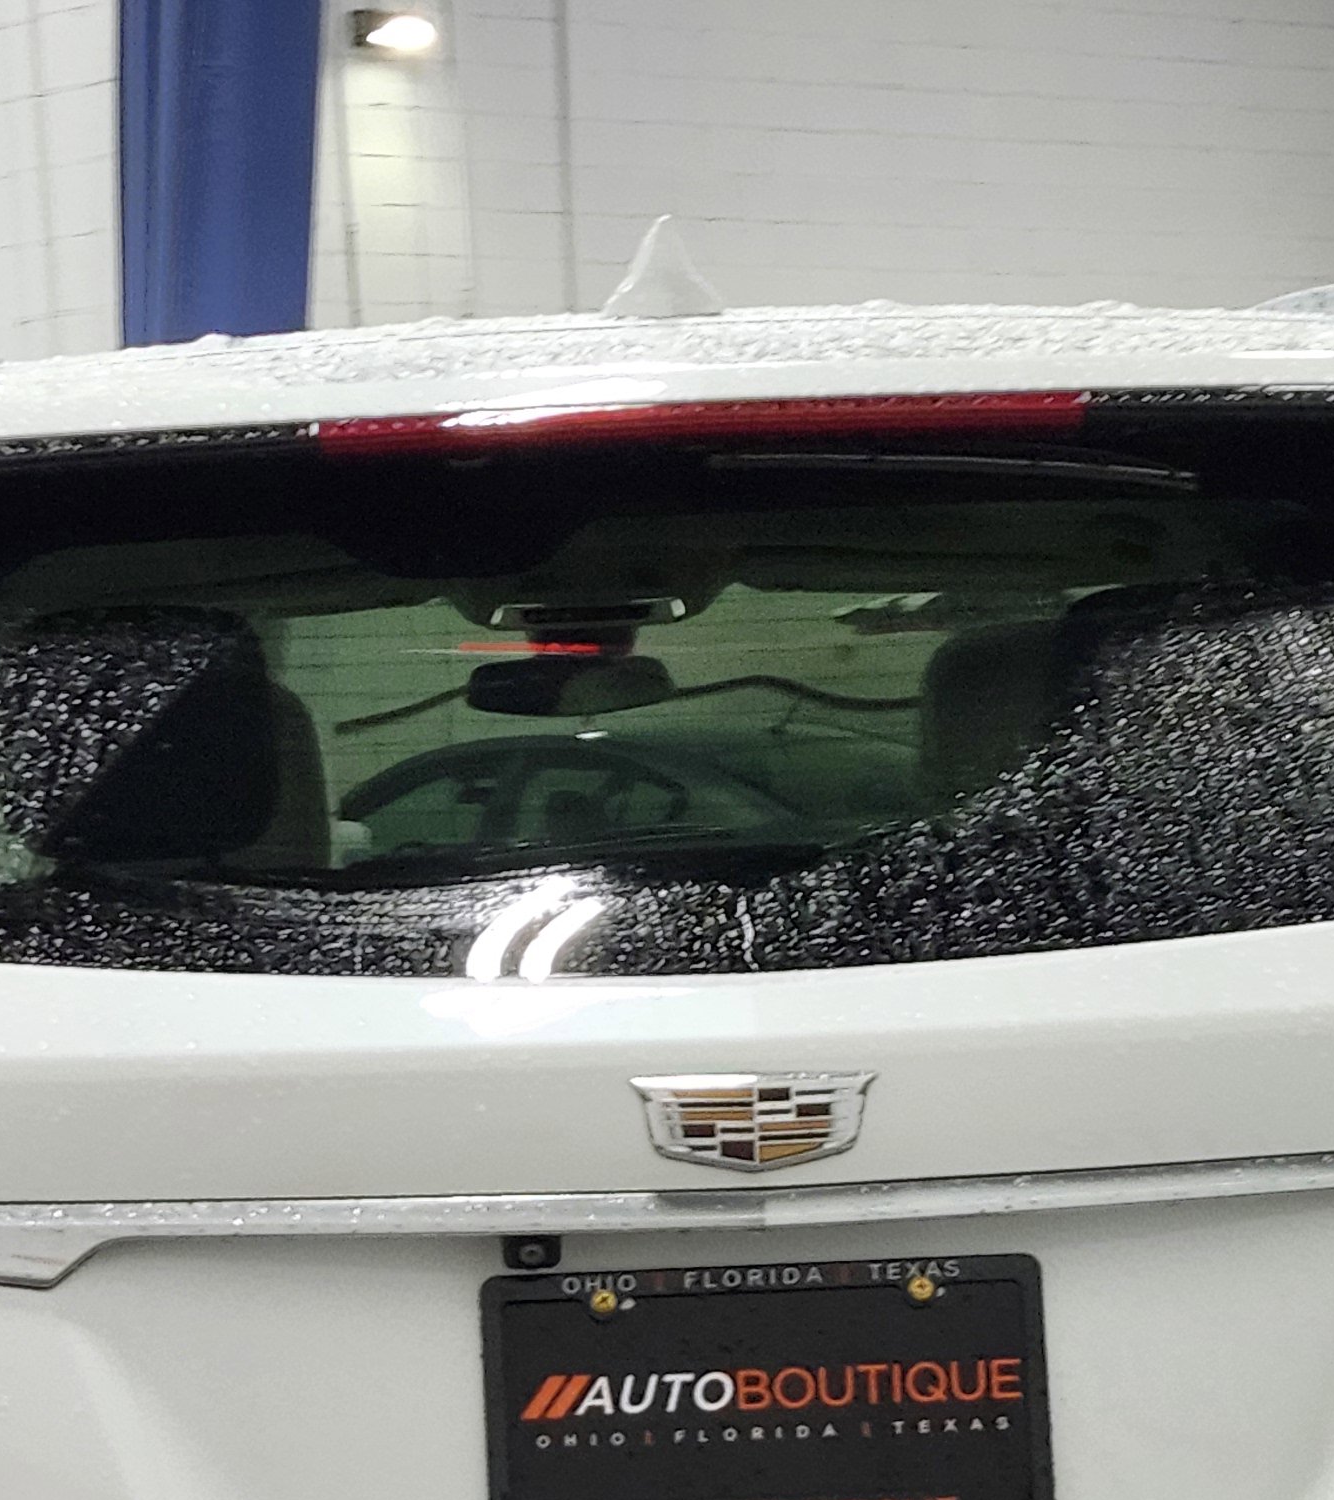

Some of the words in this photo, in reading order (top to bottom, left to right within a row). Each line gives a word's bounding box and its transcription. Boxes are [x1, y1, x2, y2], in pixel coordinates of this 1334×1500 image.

[561, 1273, 638, 1295] OHIO
[682, 1264, 824, 1291] FLORIDA
[868, 1258, 962, 1281] TEXAS
[535, 1432, 626, 1449] OHIO
[673, 1423, 840, 1444] FLORIDA
[891, 1415, 1012, 1435] TEXAS
